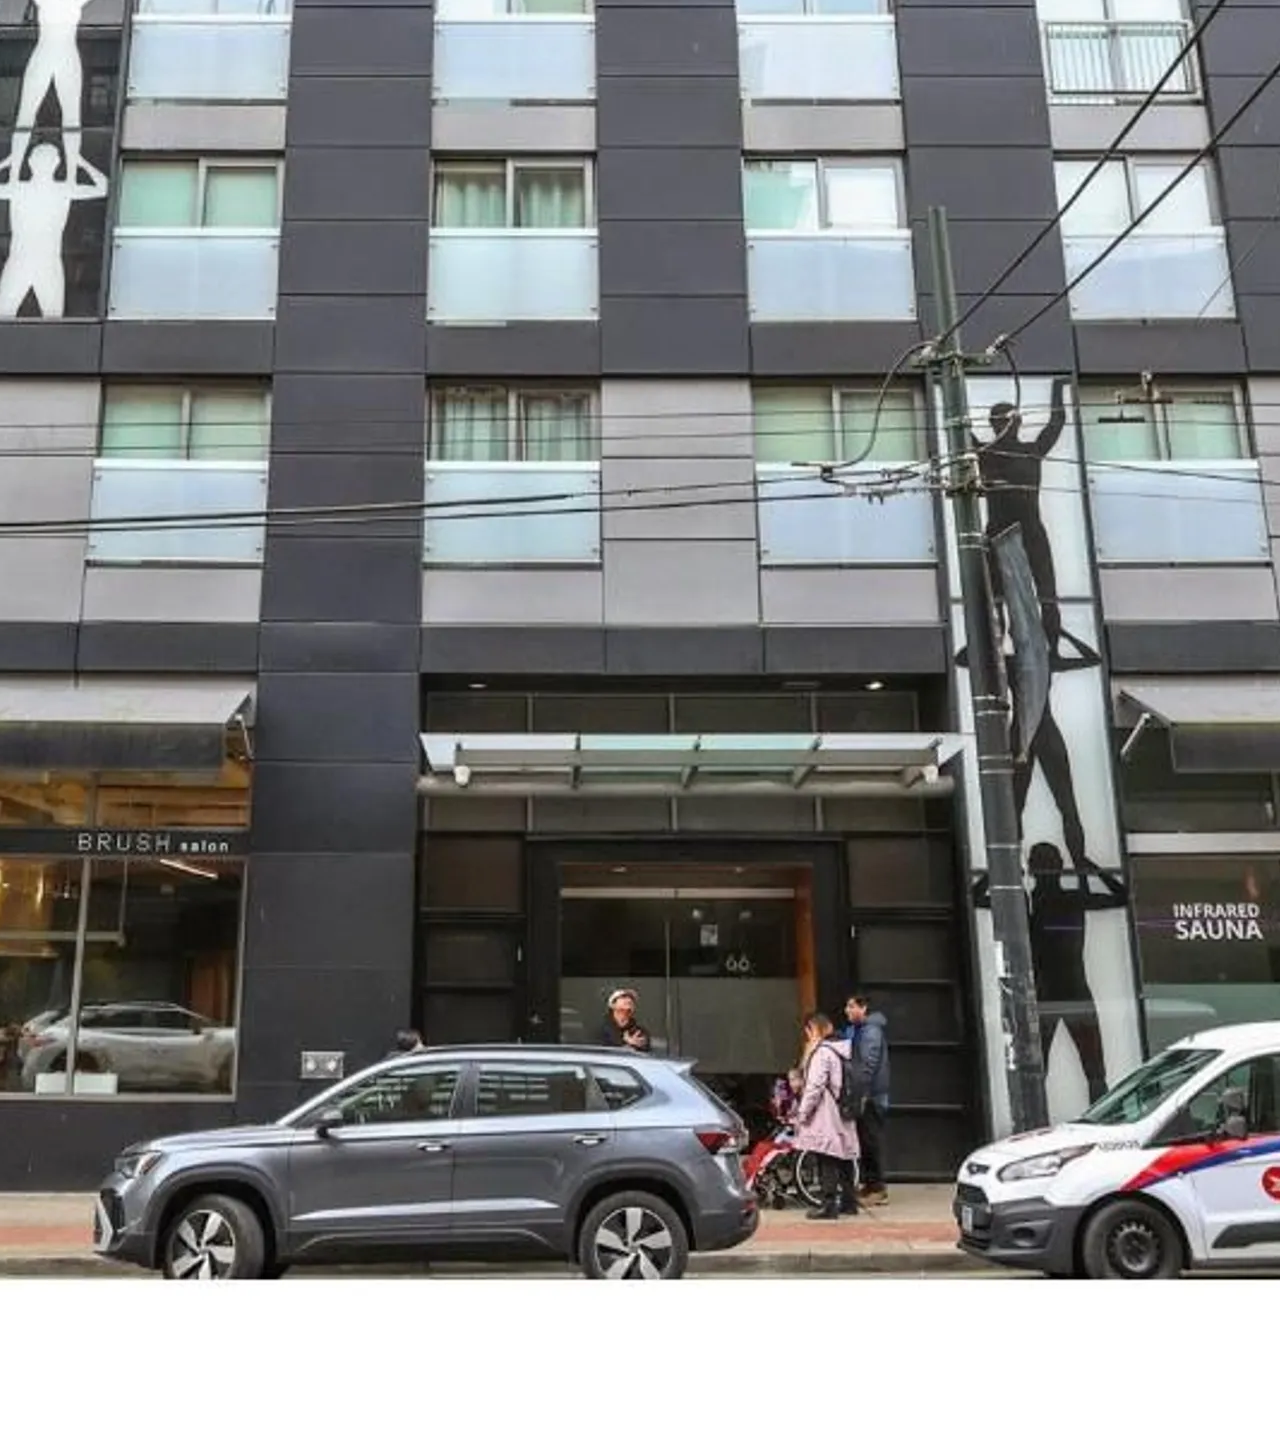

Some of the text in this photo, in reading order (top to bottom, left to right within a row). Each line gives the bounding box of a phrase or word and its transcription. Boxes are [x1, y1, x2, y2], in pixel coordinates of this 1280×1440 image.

[78, 832, 229, 852] BRUSH salon
[1173, 903, 1260, 918] INFRARED
[1175, 920, 1263, 940] SAUNA
